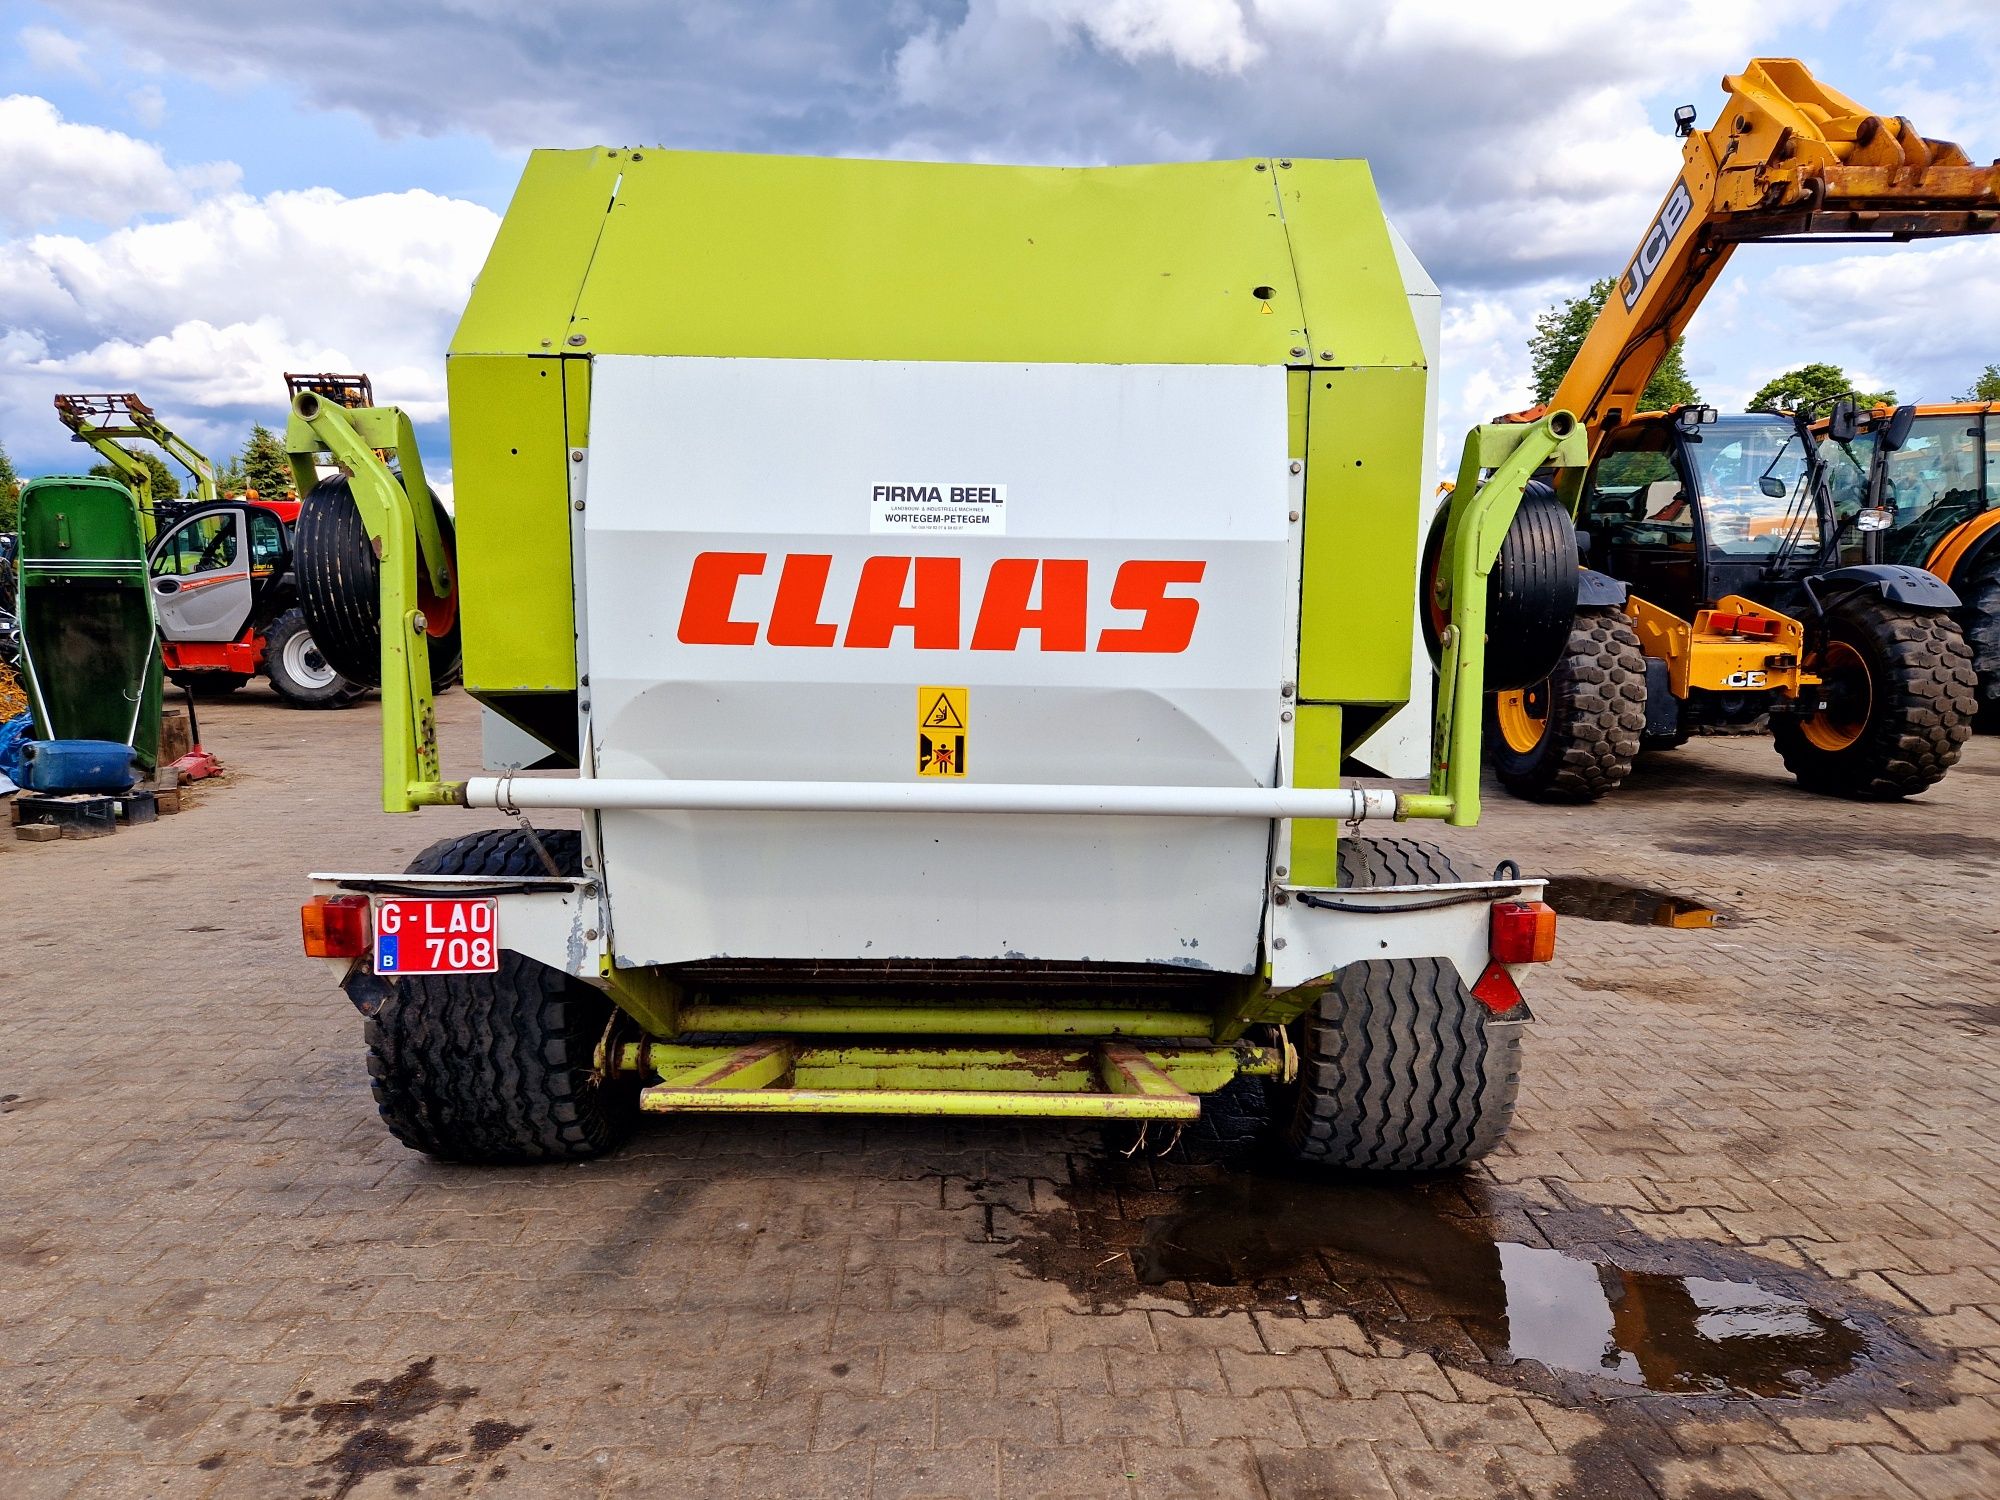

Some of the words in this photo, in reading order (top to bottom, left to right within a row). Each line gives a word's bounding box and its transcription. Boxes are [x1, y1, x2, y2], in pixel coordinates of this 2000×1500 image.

[1626, 184, 1691, 307] JCB
[873, 485, 943, 502] FIRMA
[950, 487, 1004, 503] BEEL
[885, 514, 990, 524] WORTEGEM-PETEGEM
[677, 552, 1207, 653] CLAAS
[383, 955, 394, 967] B
[426, 938, 491, 968] 708
